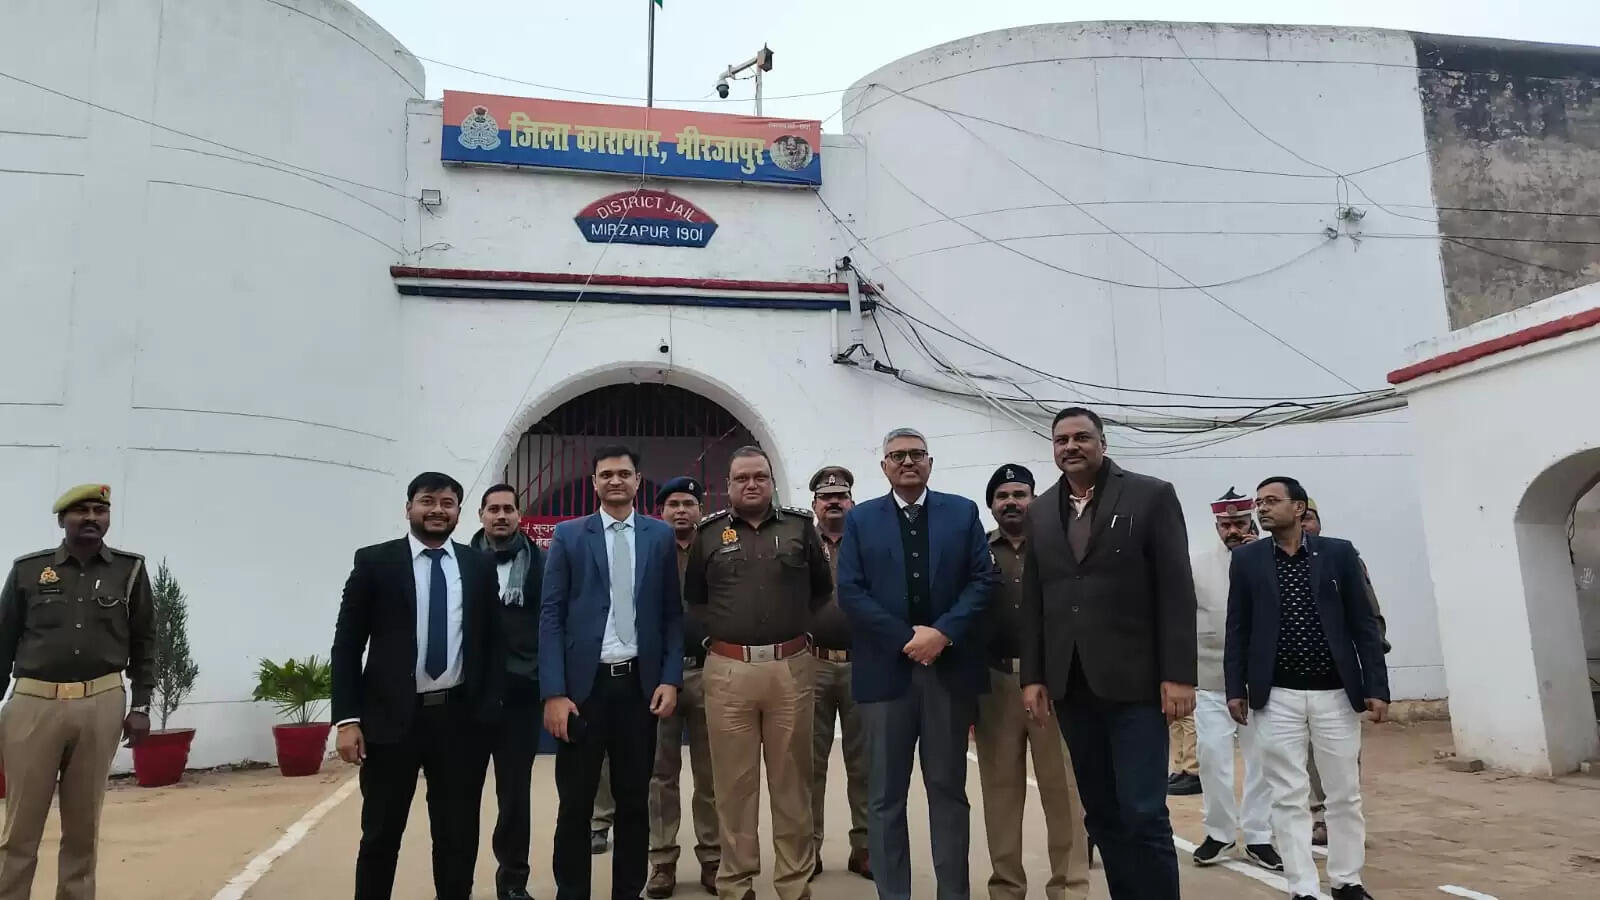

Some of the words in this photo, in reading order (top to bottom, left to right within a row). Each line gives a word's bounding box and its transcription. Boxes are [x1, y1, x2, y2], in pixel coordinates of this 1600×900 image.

[508, 111, 571, 151] जिला
[574, 125, 668, 164] कारागार,
[675, 126, 766, 175] मीरजापुर
[596, 196, 664, 220] DISTRICT
[666, 200, 697, 224] JAIL
[591, 223, 670, 239] MIRZAPUR
[676, 227, 703, 241] 1901
